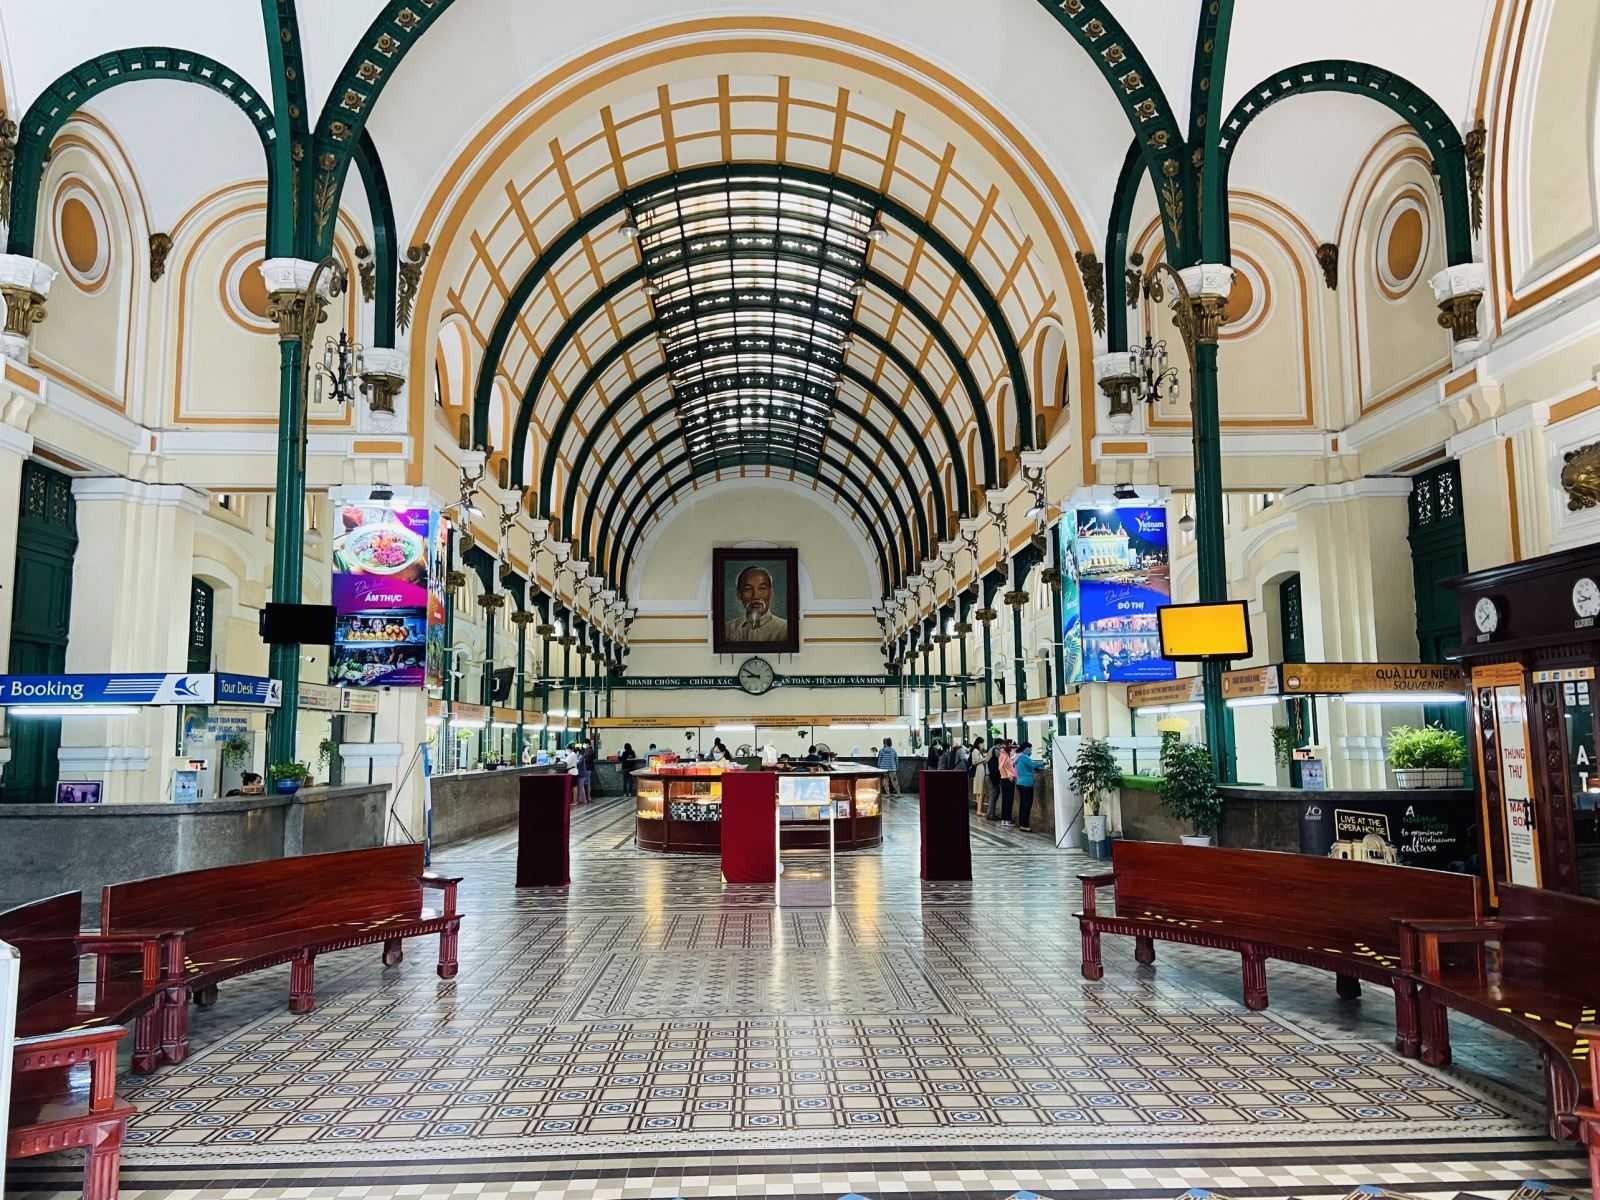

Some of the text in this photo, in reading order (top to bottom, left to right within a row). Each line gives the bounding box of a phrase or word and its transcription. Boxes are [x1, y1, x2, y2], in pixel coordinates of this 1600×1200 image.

[1117, 601, 1145, 611] ĐÔ THỊ
[1376, 667, 1401, 680] QUÀ
[1404, 669, 1428, 679] LƯU
[1430, 666, 1460, 681] NIỆM
[689, 677, 714, 685] CHÍNH
[717, 677, 733, 685] XÁC
[792, 676, 811, 684] TOÀN
[816, 676, 832, 686] TIỆN
[833, 676, 846, 685] LỢI
[851, 676, 866, 684] VĂN
[1393, 680, 1445, 690] SOUVENIR
[11, 681, 84, 700] Booking
[221, 680, 254, 695] Tour Desk
[1504, 746, 1526, 759] THÙNG
[1508, 764, 1523, 778] THƯ
[1405, 805, 1415, 817] A
[1510, 802, 1526, 813] MAI
[1340, 815, 1381, 827] LIVE AT THE
[1338, 823, 1361, 832] OPERA
[1401, 837, 1437, 853] culture
